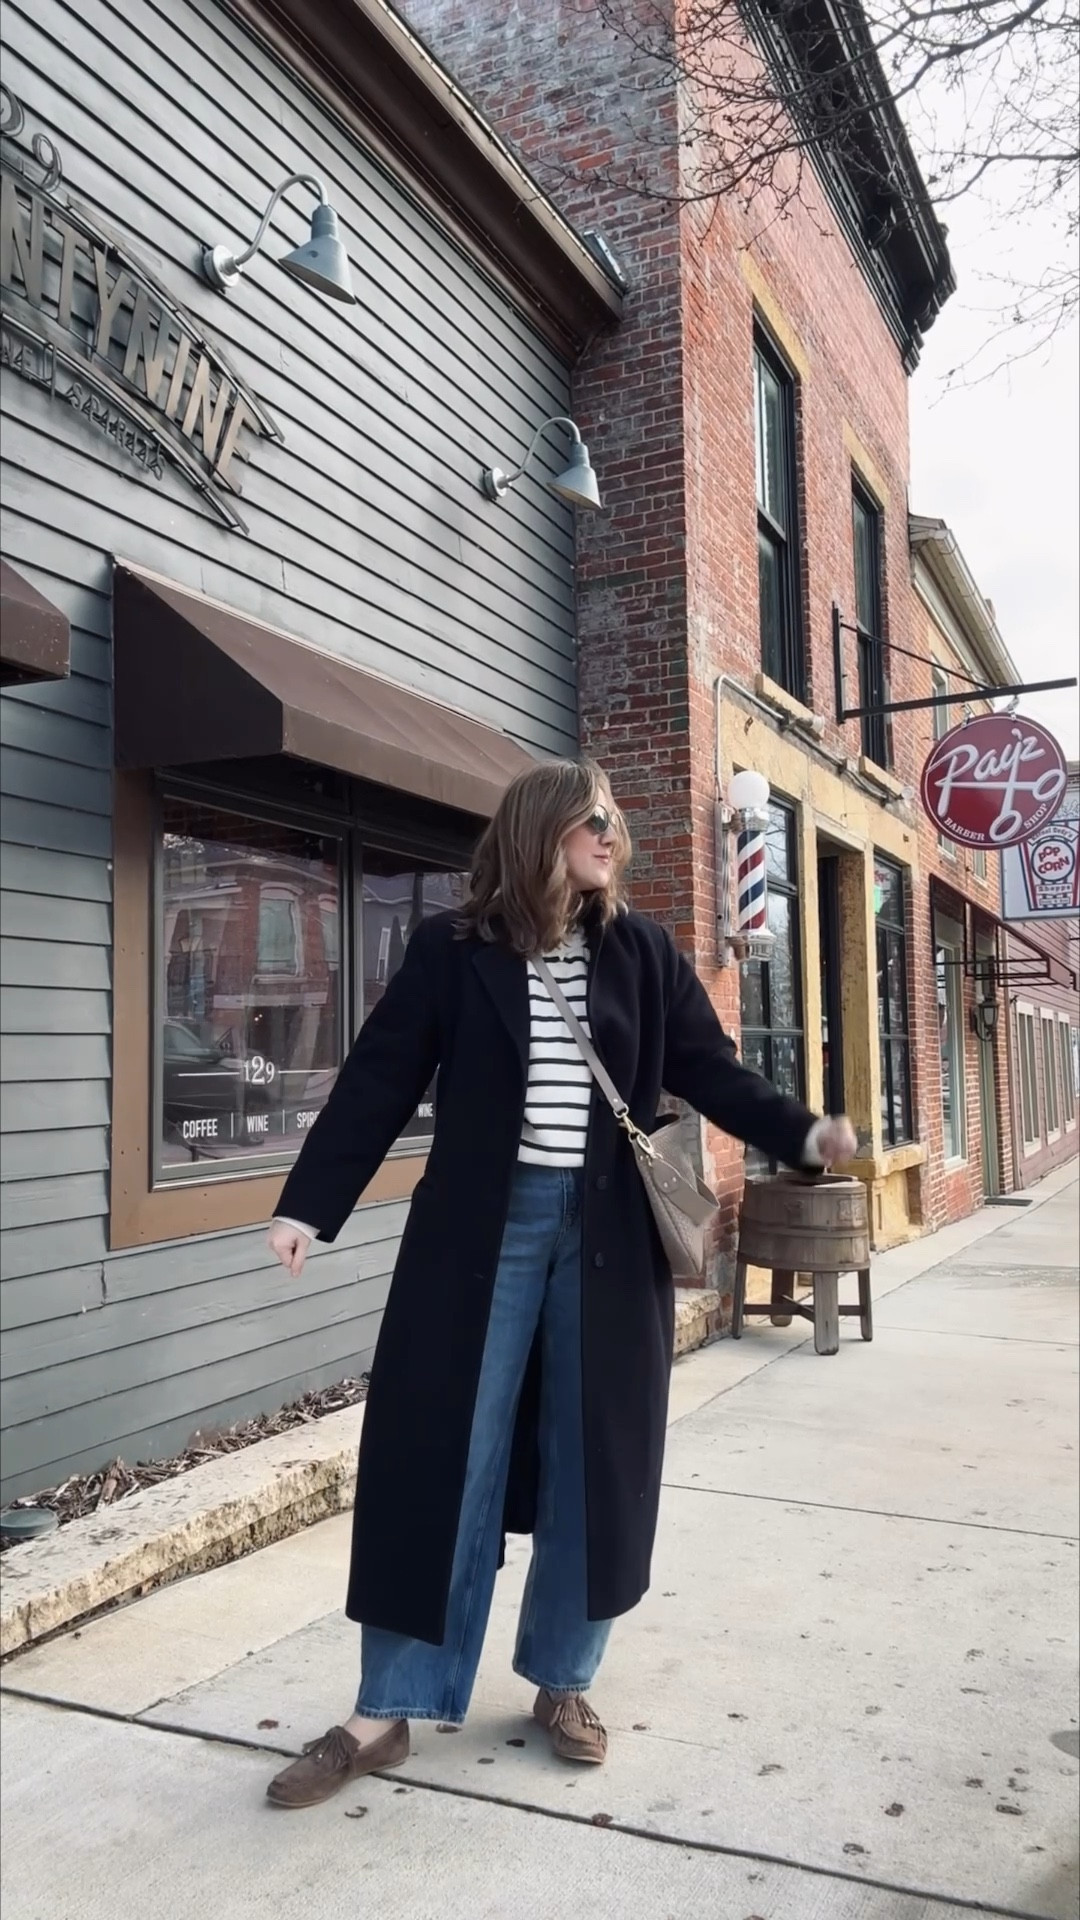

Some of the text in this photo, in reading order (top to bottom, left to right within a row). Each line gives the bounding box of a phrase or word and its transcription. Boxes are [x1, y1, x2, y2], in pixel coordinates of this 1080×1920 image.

[943, 803, 1048, 842] BARBER SHOP
[1038, 846, 1061, 862] POP
[1038, 856, 1070, 874] CORN
[243, 1056, 275, 1085] 129
[182, 1118, 218, 1139] COFFEE
[246, 1114, 269, 1133] WINE
